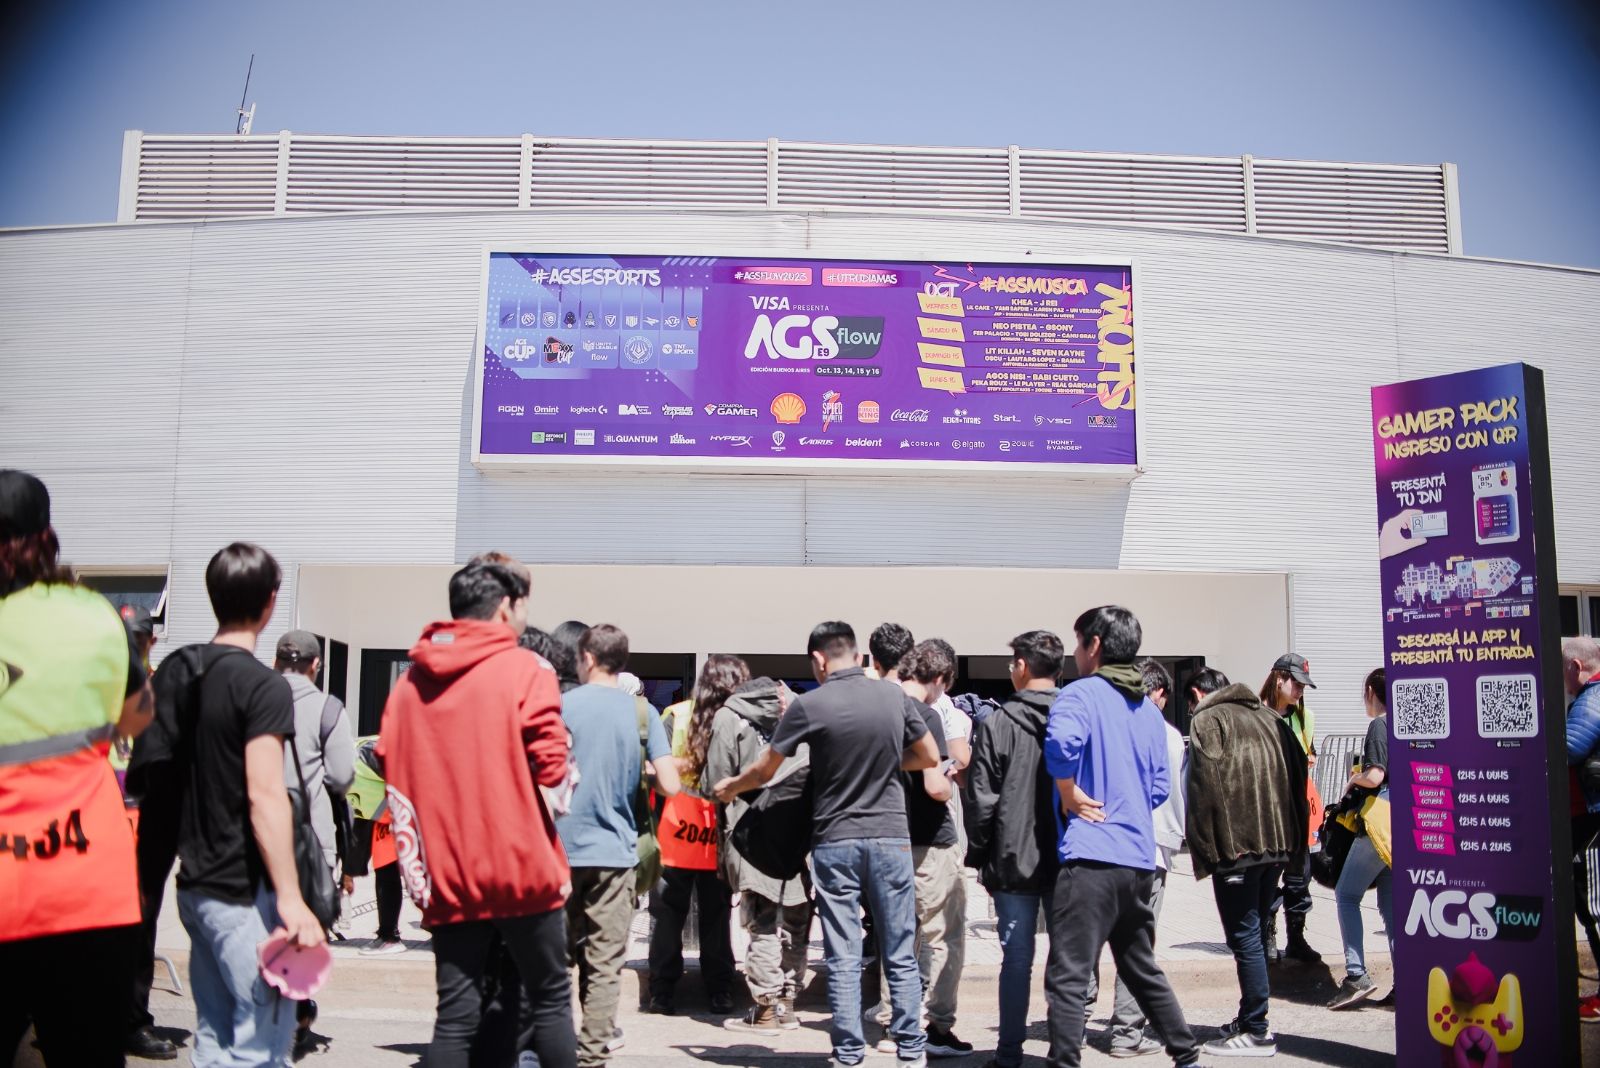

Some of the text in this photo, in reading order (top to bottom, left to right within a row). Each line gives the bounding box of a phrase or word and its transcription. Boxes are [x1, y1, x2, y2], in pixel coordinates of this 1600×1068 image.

[531, 268, 661, 287] #AGSESPORTS
[924, 281, 960, 298] OCT
[748, 295, 790, 311] VISA
[993, 322, 1010, 330] NEO
[744, 314, 840, 360] AGS
[837, 327, 882, 345] flow
[504, 345, 536, 361] CUP
[817, 348, 830, 357] E9
[570, 405, 597, 415] logitech
[717, 407, 759, 417] GAMER
[1377, 396, 1518, 439] GAMER PACK
[615, 435, 658, 443] QUANTUM
[845, 437, 883, 447] beldent
[962, 440, 985, 449] elgato
[1384, 426, 1518, 460] INGRESO CON QR
[1391, 472, 1447, 493] PRESENTÁ
[1397, 489, 1442, 508] TU DNI
[1397, 627, 1521, 648] DESCARGÁ LA APP Y
[1391, 645, 1535, 666] PRESENTÁ TU ENTRADA
[1478, 771, 1485, 780] A
[1479, 794, 1486, 803] A
[1480, 817, 1487, 827] A
[1481, 841, 1488, 851] A
[1406, 869, 1486, 888] VISA PRESENTA
[1404, 888, 1498, 941] AGS
[1495, 906, 1541, 927] flow
[1475, 927, 1488, 937] E9
